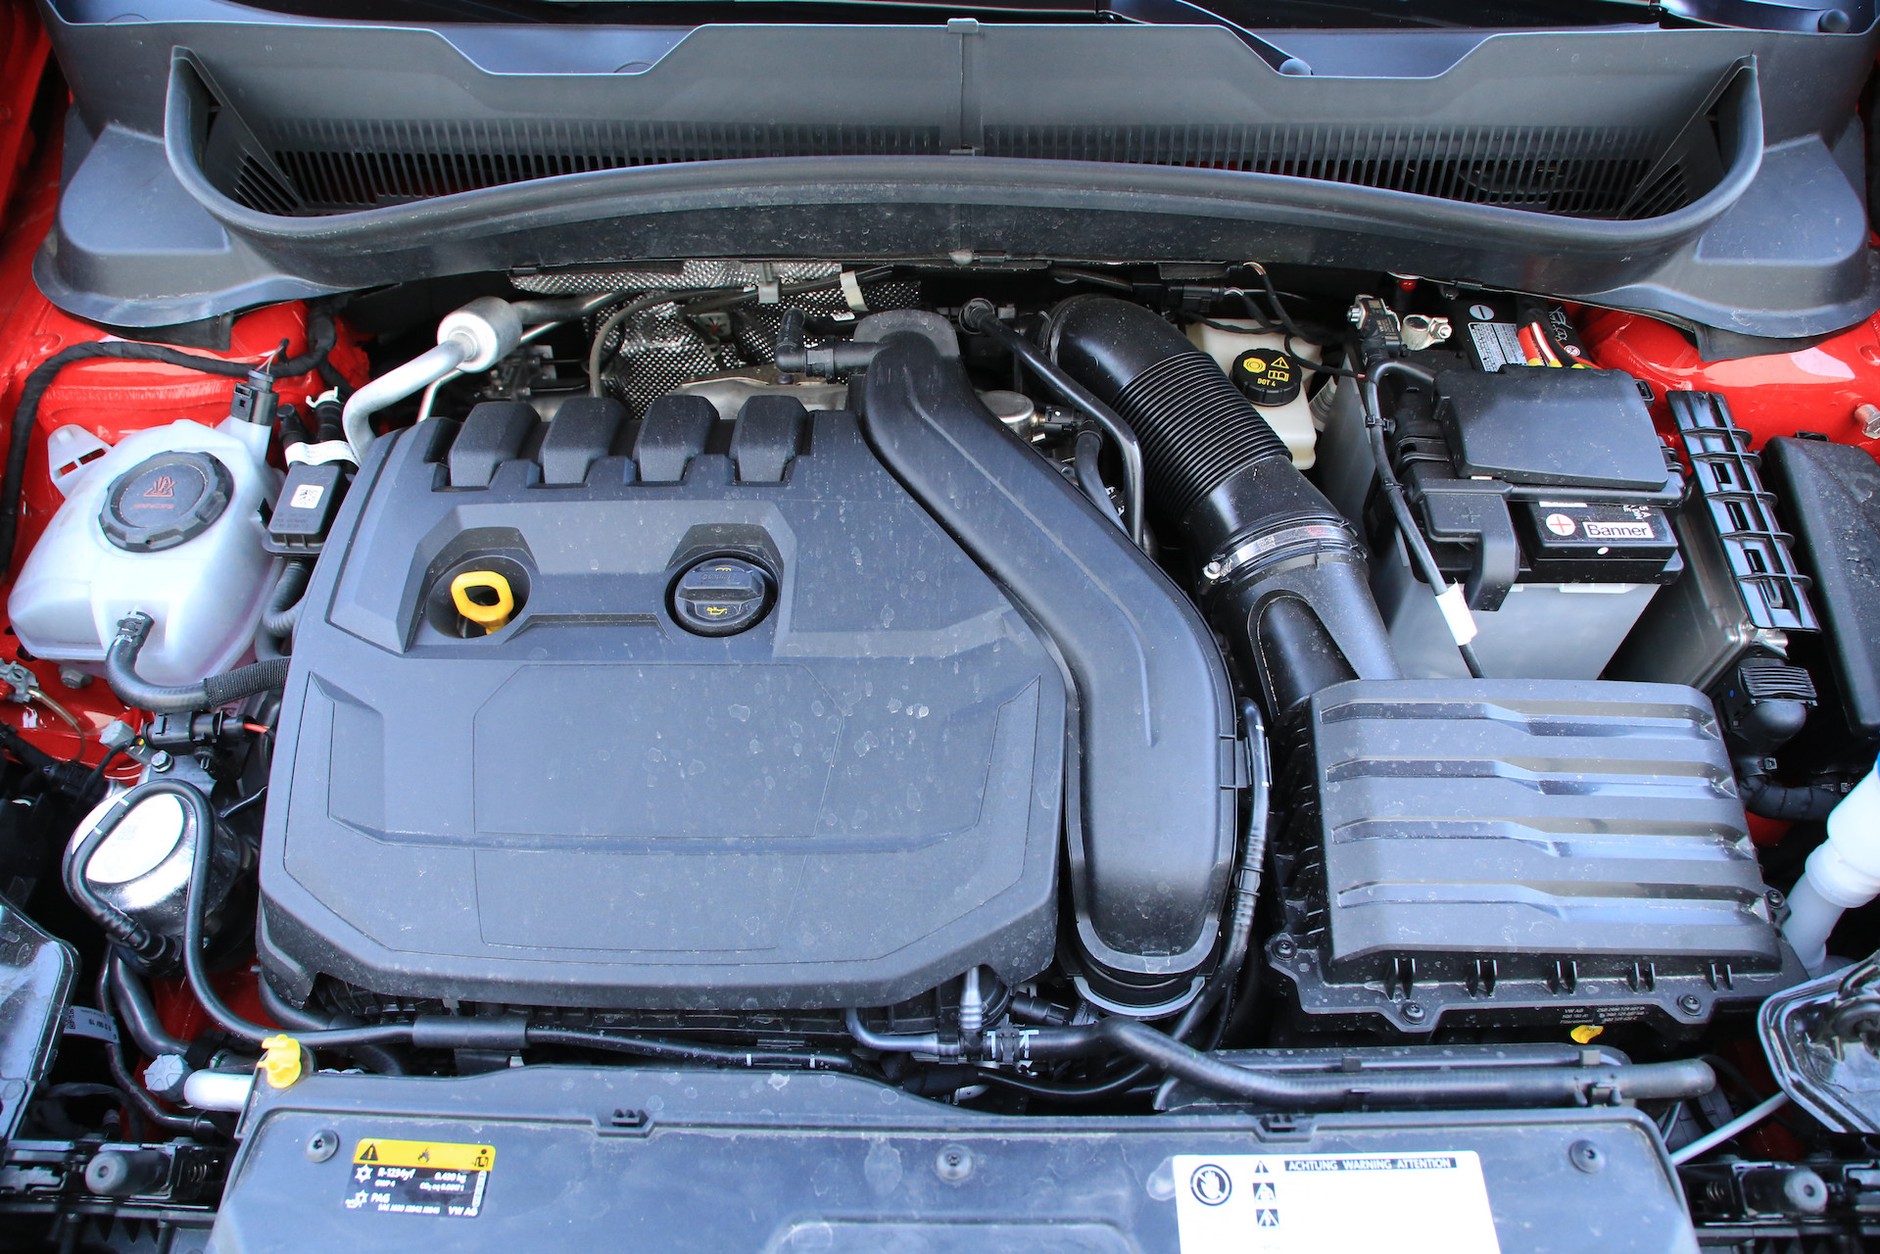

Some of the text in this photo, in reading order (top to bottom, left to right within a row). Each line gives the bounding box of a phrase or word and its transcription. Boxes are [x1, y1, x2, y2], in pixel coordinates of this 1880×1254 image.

[1586, 524, 1648, 536] Banner
[1288, 1157, 1451, 1171] ACHTUNG WARNING ATTENTION
